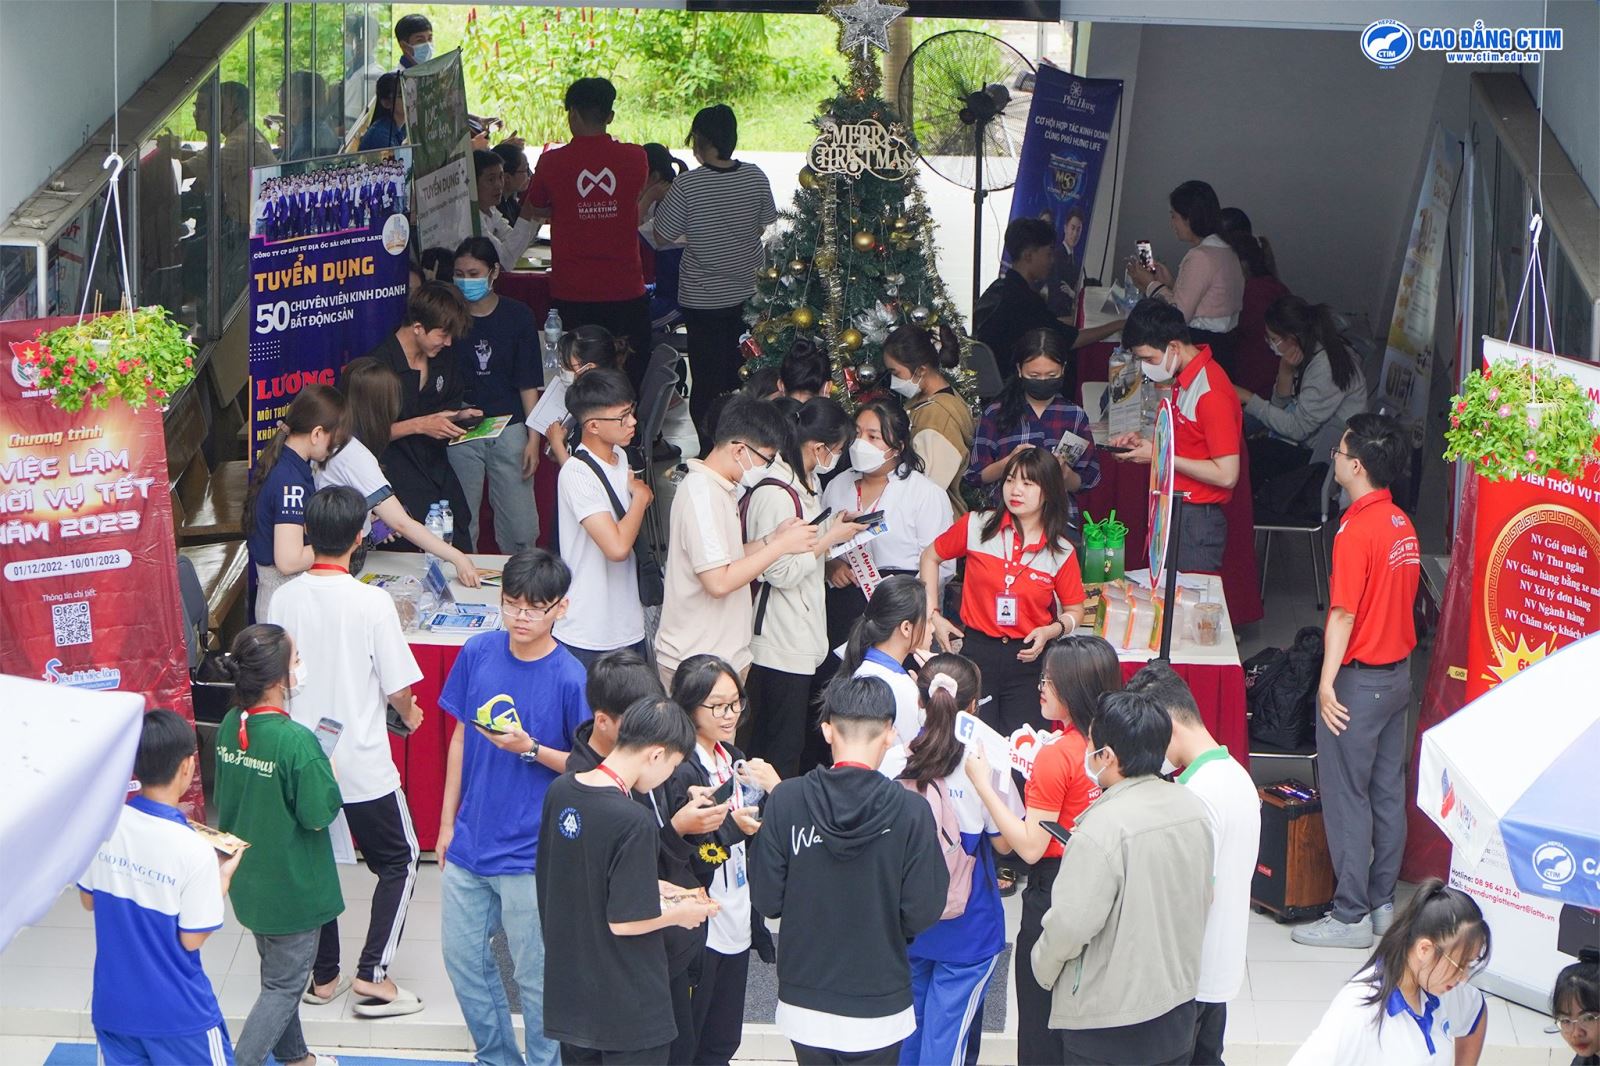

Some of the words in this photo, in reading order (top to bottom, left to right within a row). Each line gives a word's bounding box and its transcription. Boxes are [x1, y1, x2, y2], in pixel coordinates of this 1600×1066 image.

[829, 119, 899, 149] MERRY
[253, 251, 271, 259] CÔNG
[254, 254, 317, 293] TUYỂN
[322, 256, 375, 285] DỤNG
[290, 295, 329, 312] CHUYÊN
[329, 291, 349, 306] VIÊN
[350, 289, 374, 303] KINH
[375, 284, 406, 299] DOANH
[255, 301, 291, 335] 50
[290, 313, 307, 329] BẤT
[308, 310, 337, 328] ĐỘNG
[337, 306, 354, 322] SẢN
[8, 431, 63, 448] Chương
[68, 425, 104, 441] trình
[0, 455, 59, 483] VIỆC
[70, 448, 129, 475] LÀM
[44, 483, 85, 511] VỤ
[96, 473, 155, 503] TẾT
[283, 485, 305, 508] HR
[1547, 477, 1575, 495] THỜI
[1577, 485, 1592, 502] VỤ
[60, 510, 141, 538] 2023
[1531, 533, 1543, 545] NV
[1544, 538, 1560, 550] Gói
[1561, 543, 1576, 555] quà
[14, 561, 63, 576] 01/12/2022
[71, 554, 120, 569] 10/01/2023
[861, 552, 876, 578] dụng
[1532, 550, 1545, 562] NV
[1546, 554, 1563, 568] Thu
[1565, 561, 1584, 574] ngân
[1505, 559, 1519, 571] NV
[1520, 563, 1538, 577] Giao
[1539, 569, 1560, 586] hàng
[1561, 575, 1581, 592] bằng
[1581, 583, 1589, 593] xe
[42, 594, 63, 602] Thông
[1519, 580, 1533, 592] NV
[1533, 583, 1546, 597] Xử
[1557, 591, 1572, 604] đơn
[1574, 595, 1592, 613] hàng
[1504, 607, 1519, 620] NV
[1520, 612, 1542, 629] Chăm
[1543, 620, 1557, 634] sóc
[1524, 597, 1537, 610] NV
[1538, 601, 1565, 619] Ngành
[1567, 610, 1585, 627] hàng
[148, 869, 176, 886] CTIM
[1450, 878, 1463, 889] Mail:
[1451, 868, 1474, 884] Hotline:
[1474, 878, 1484, 887] 08
[1494, 884, 1503, 893] 40
[1512, 890, 1520, 900] 41
